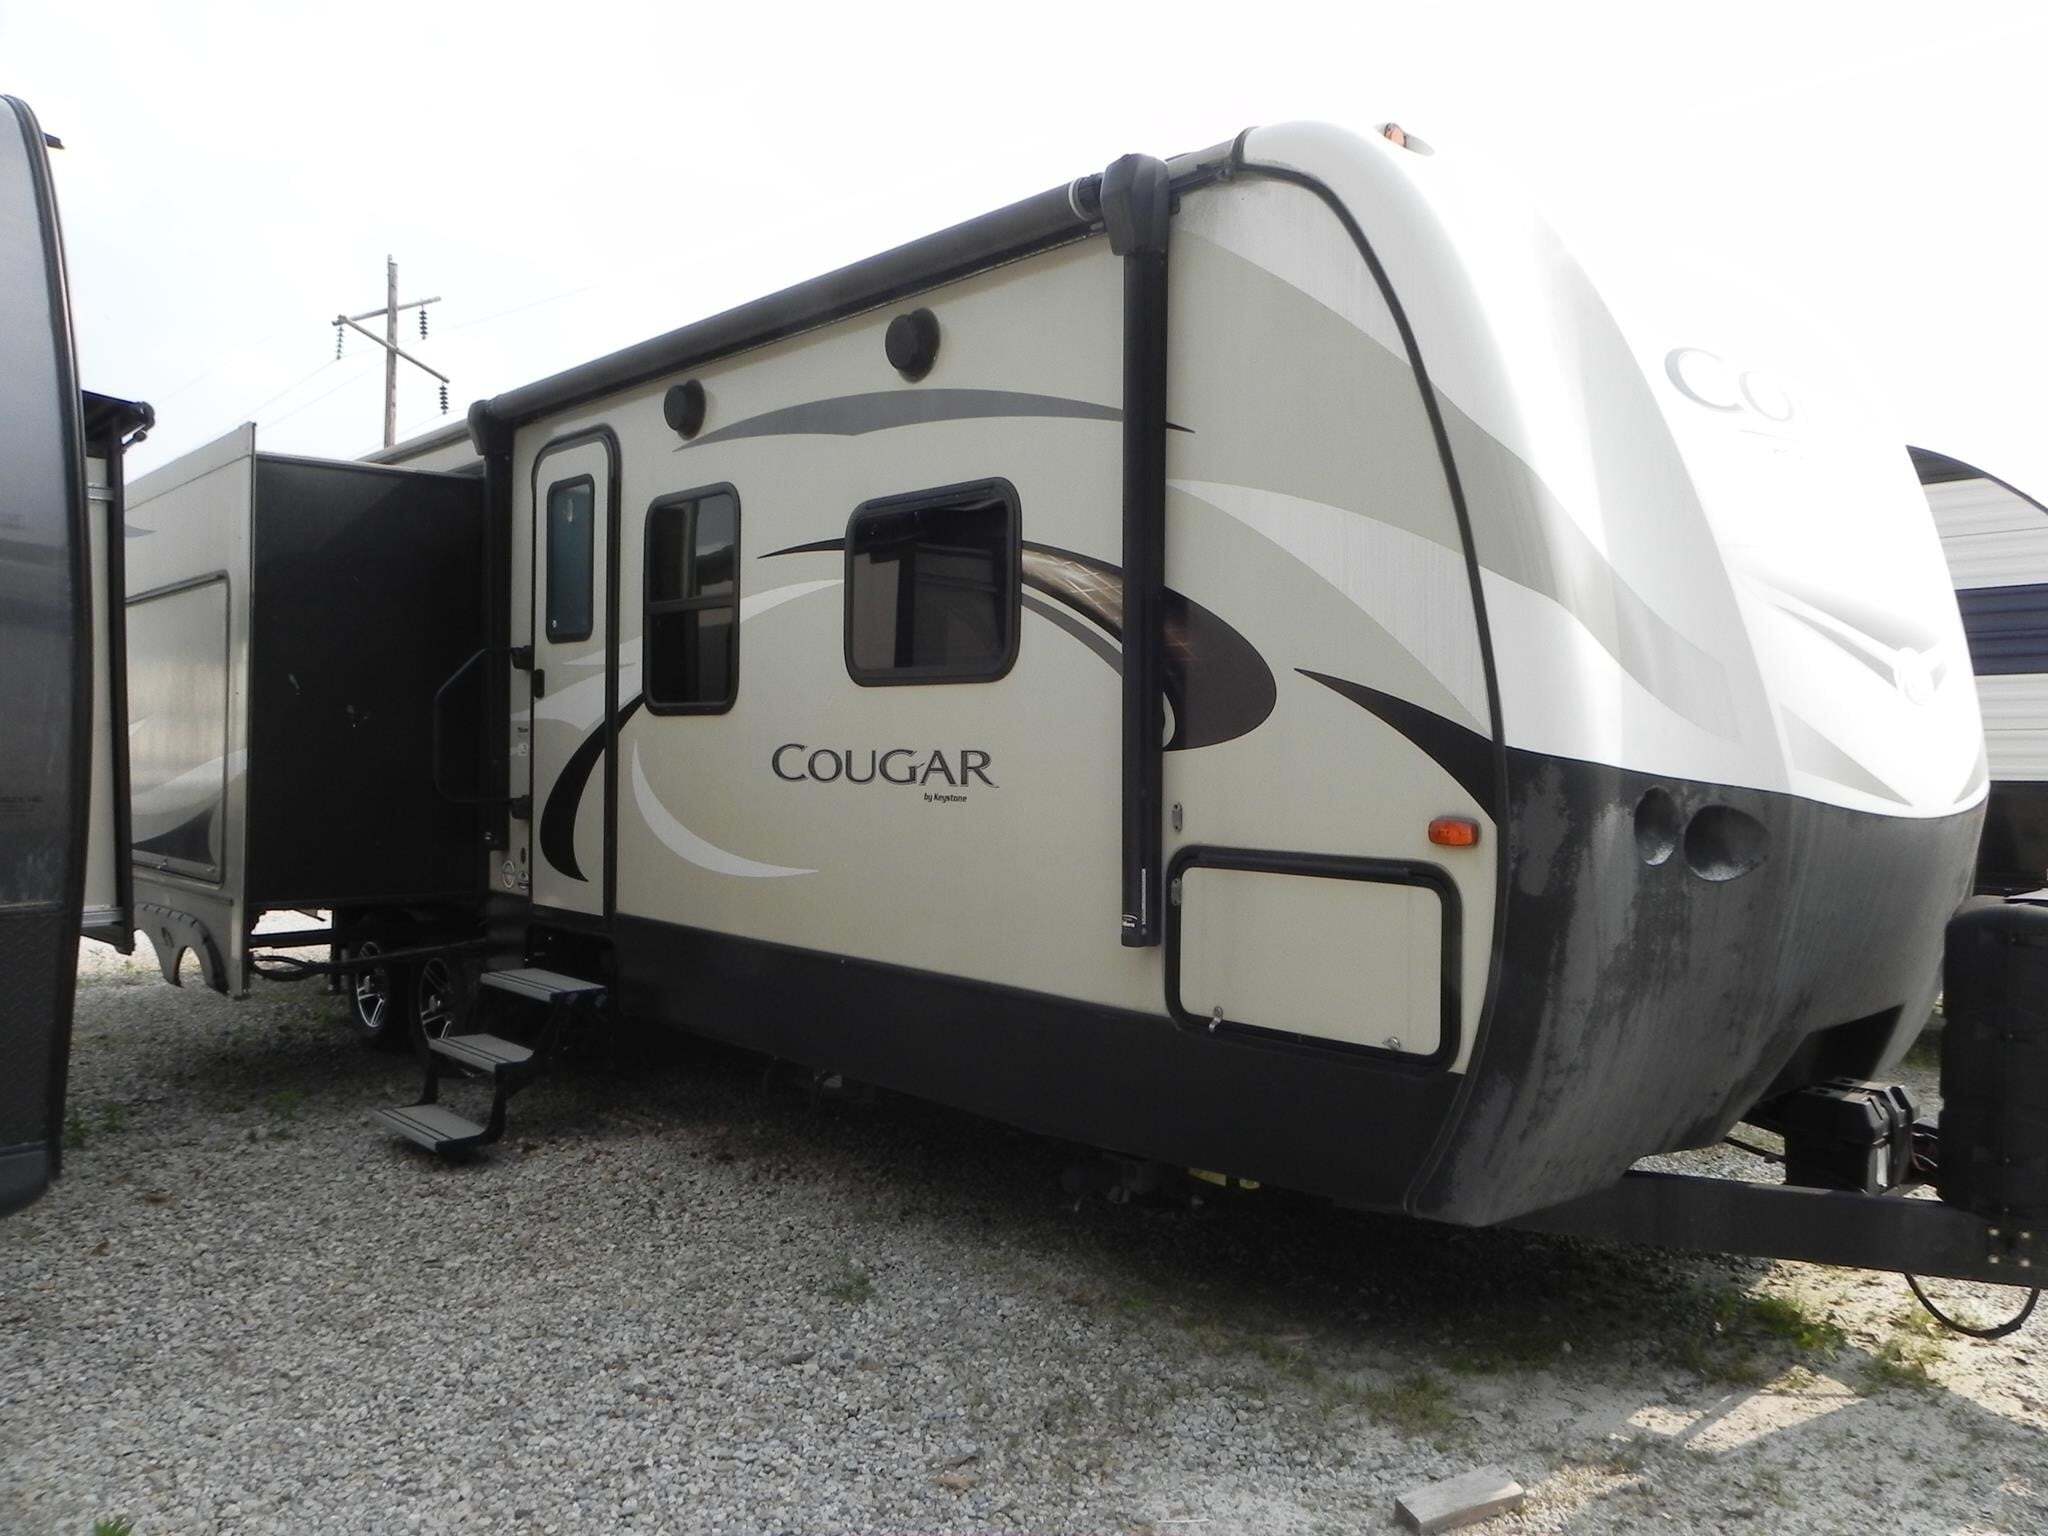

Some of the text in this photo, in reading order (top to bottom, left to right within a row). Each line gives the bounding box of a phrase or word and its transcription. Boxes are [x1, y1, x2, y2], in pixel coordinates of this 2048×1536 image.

[772, 743, 999, 788] COUGAR
[923, 793, 968, 803] by Keystone
